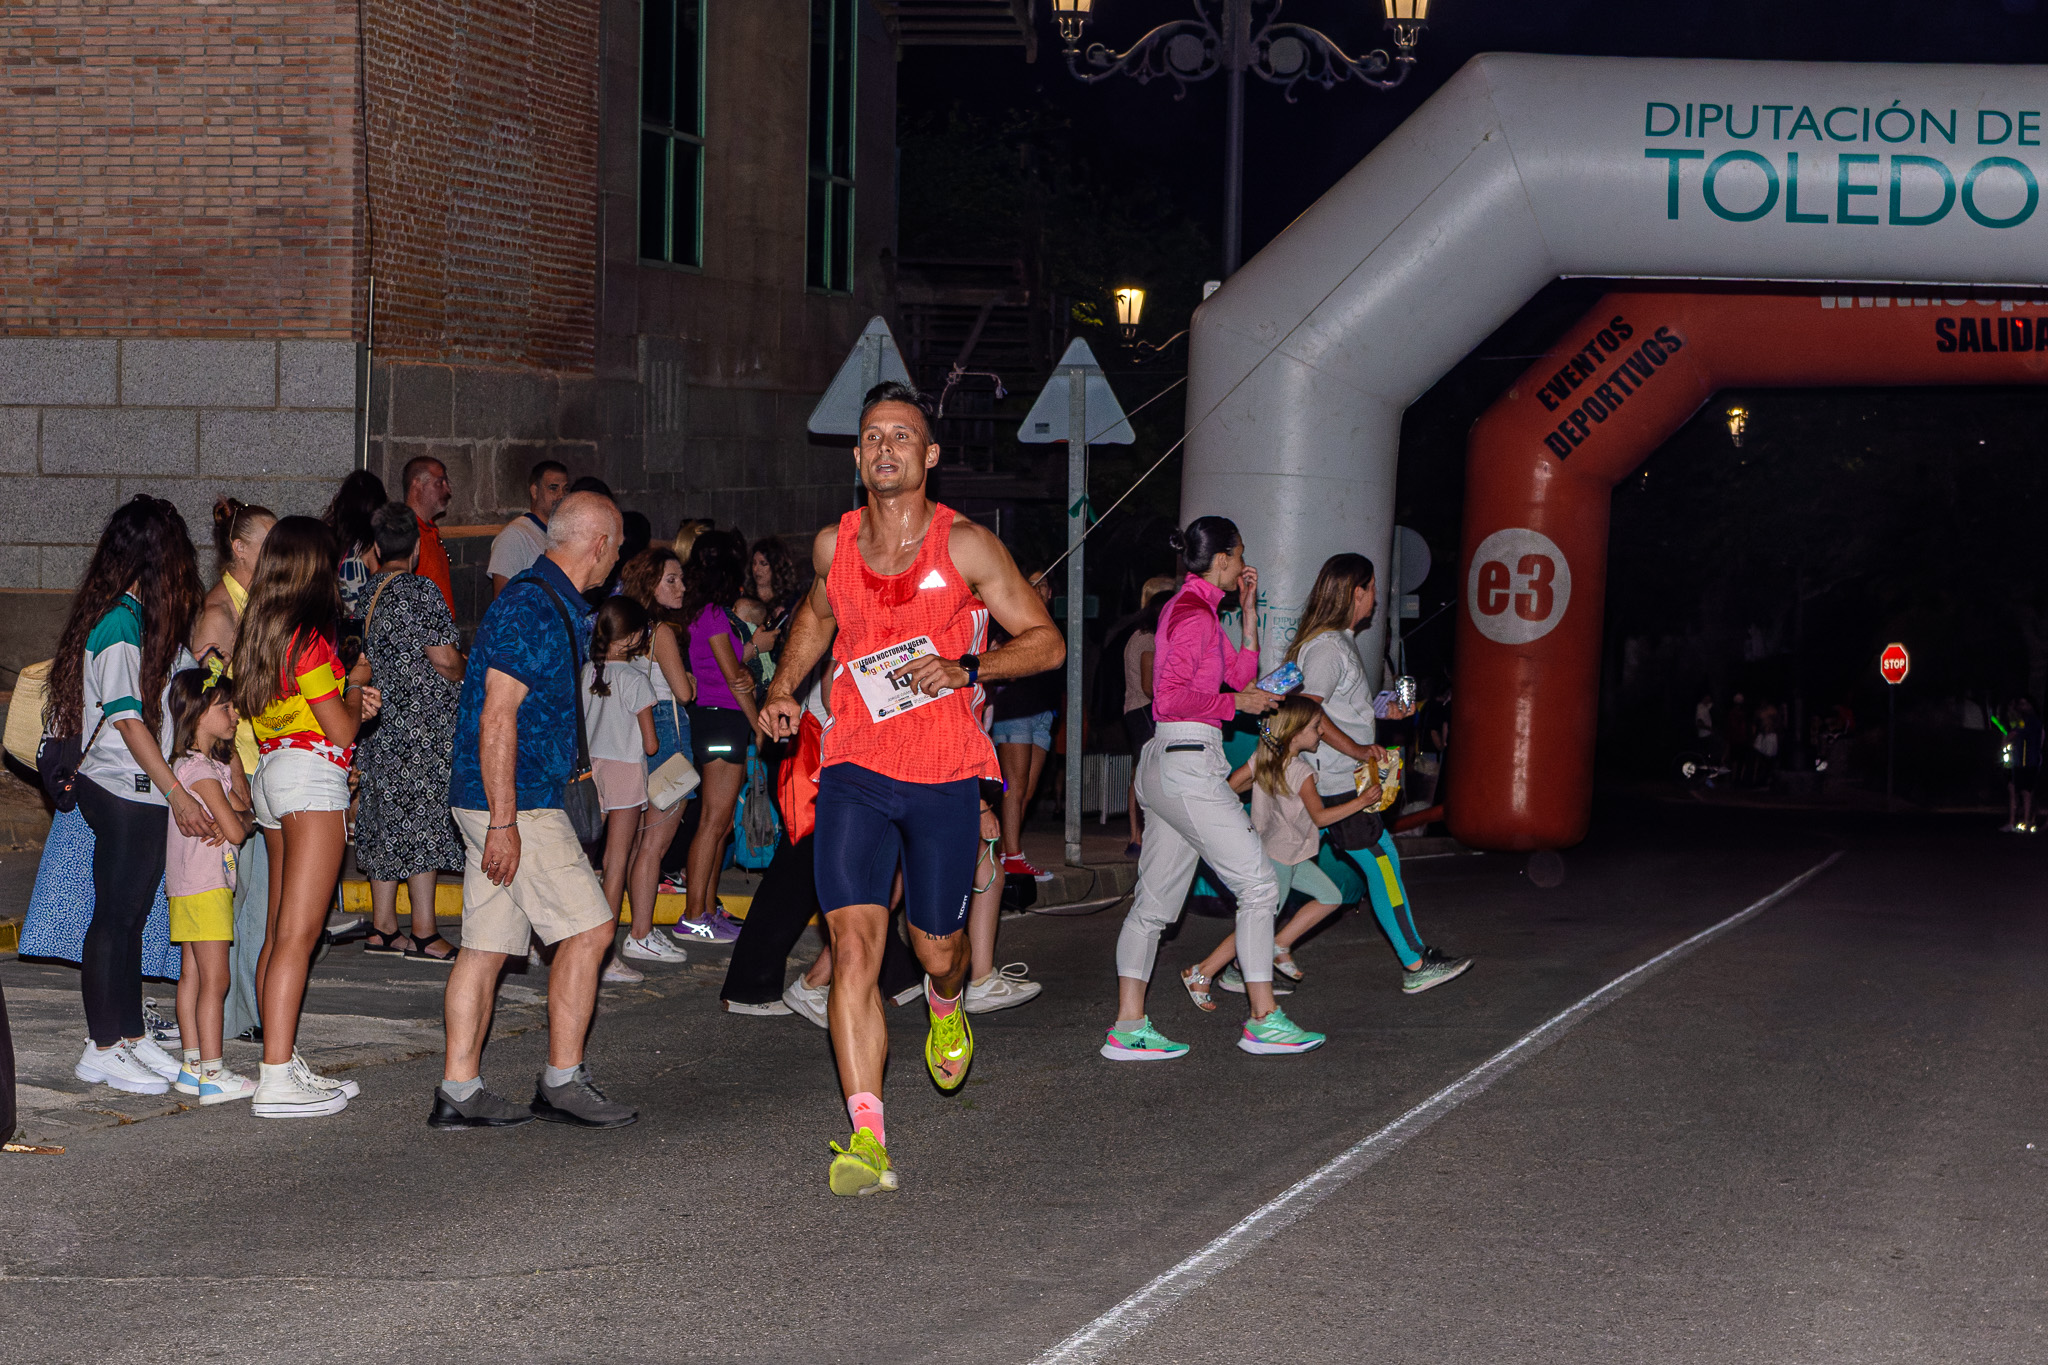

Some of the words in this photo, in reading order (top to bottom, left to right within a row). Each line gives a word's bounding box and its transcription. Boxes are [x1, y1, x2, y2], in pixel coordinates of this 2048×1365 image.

[1645, 99, 1957, 144] DIPUTACIÓN
[1977, 110, 2041, 146] DE
[1644, 148, 2040, 229] TOLEDO
[1536, 315, 1634, 412] EVENTOS
[1544, 325, 1683, 461] DEPORTIVOS
[1477, 554, 1555, 622] e3
[876, 645, 908, 661] NOCTURNA
[908, 638, 928, 649] UGENA
[1884, 658, 1905, 670] STOP
